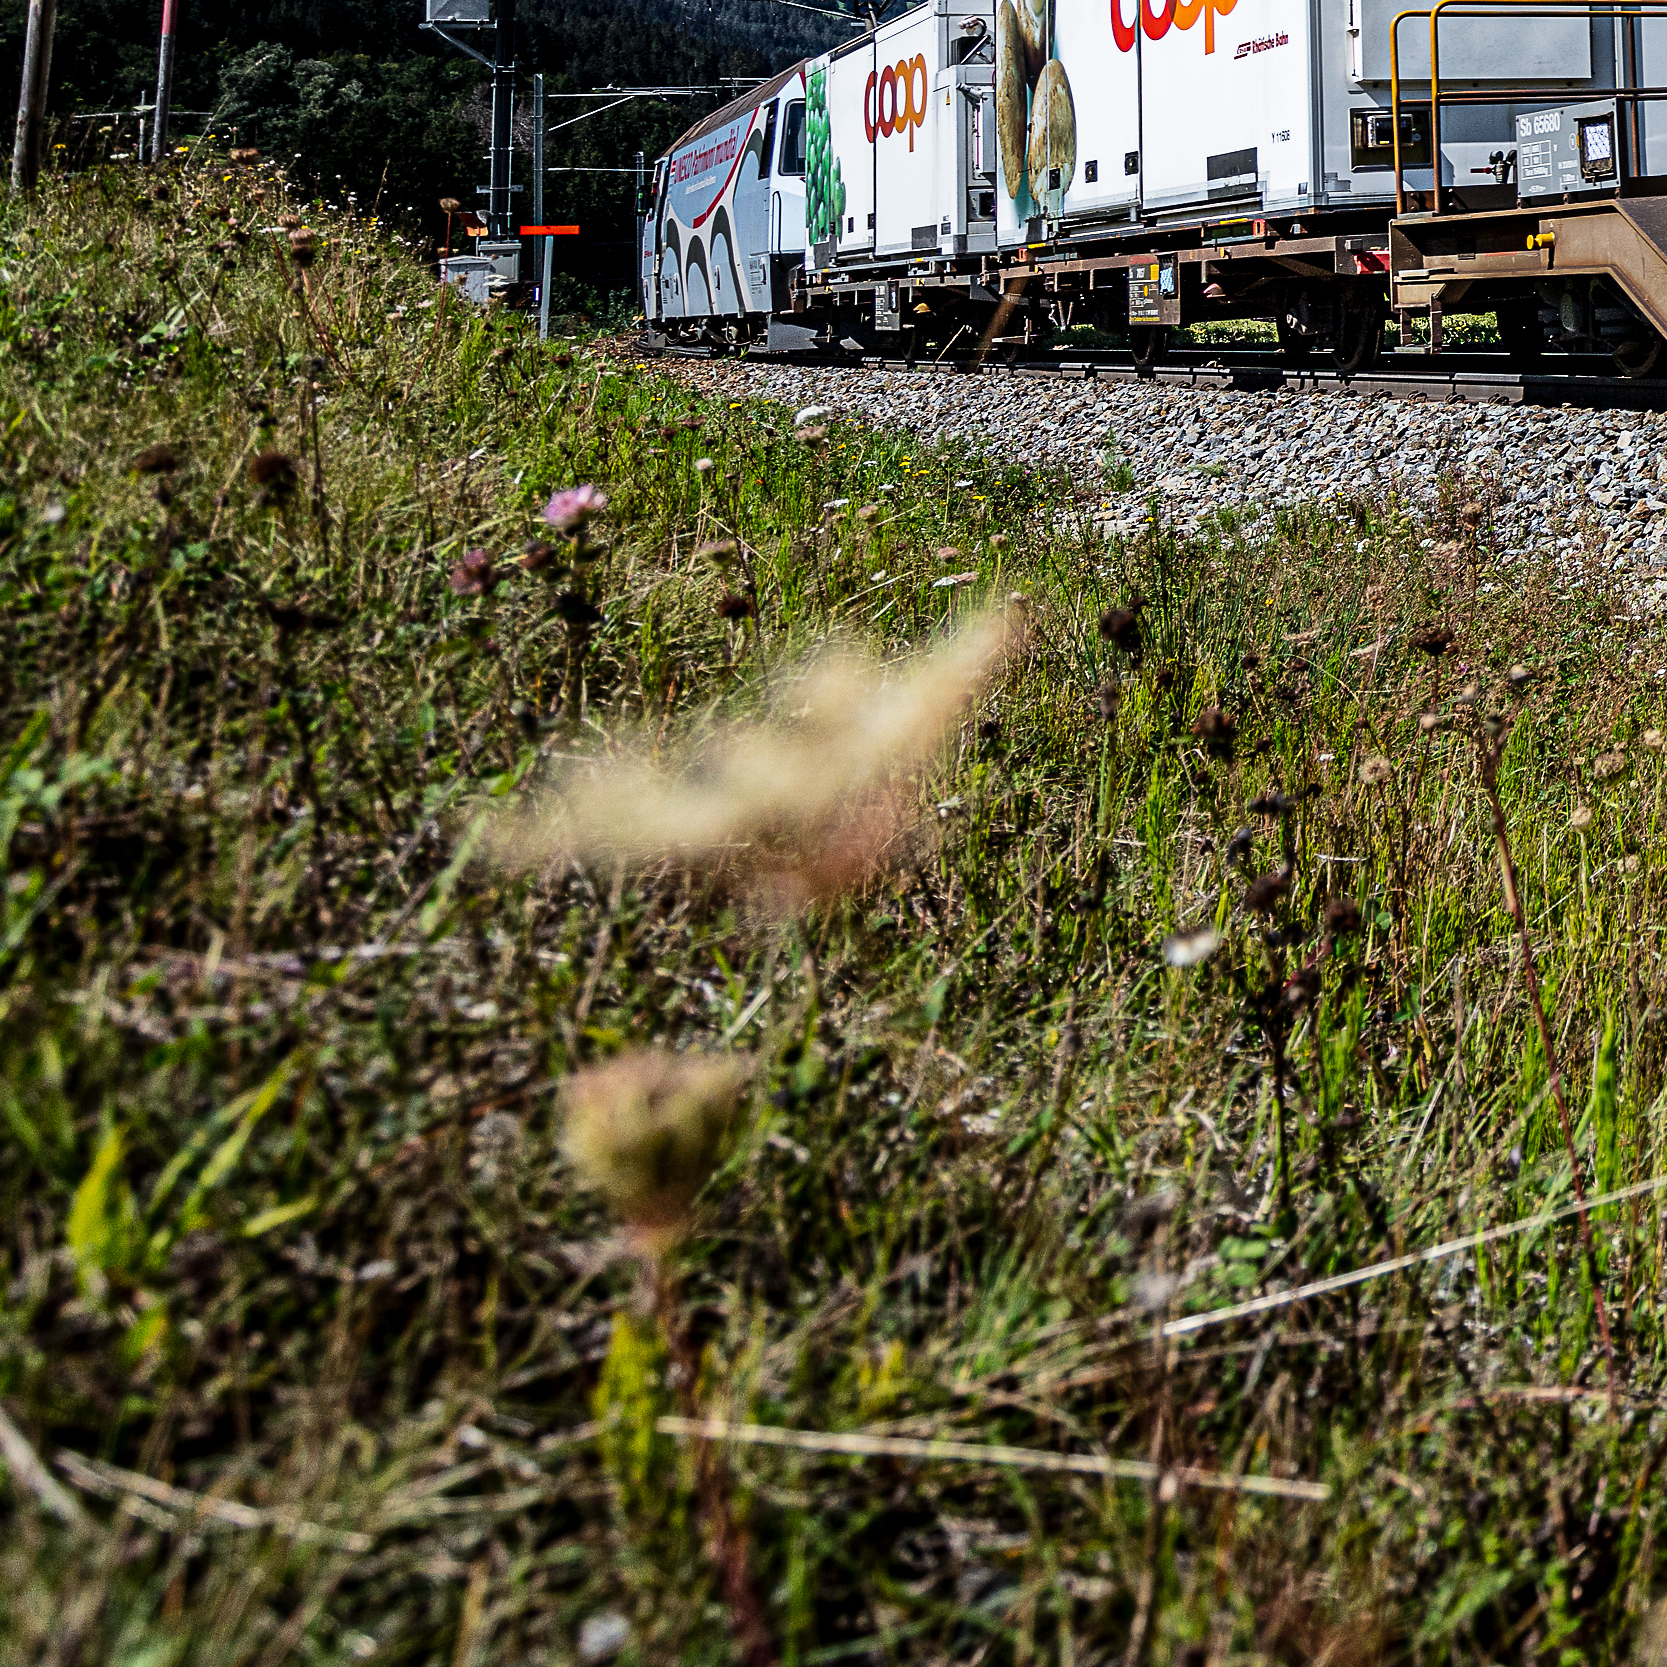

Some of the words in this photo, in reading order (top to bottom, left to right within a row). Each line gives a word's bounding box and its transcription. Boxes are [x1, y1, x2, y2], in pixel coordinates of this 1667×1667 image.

[865, 53, 928, 152] coop
[1520, 117, 1532, 137] Sb
[1533, 112, 1560, 135] 65680
